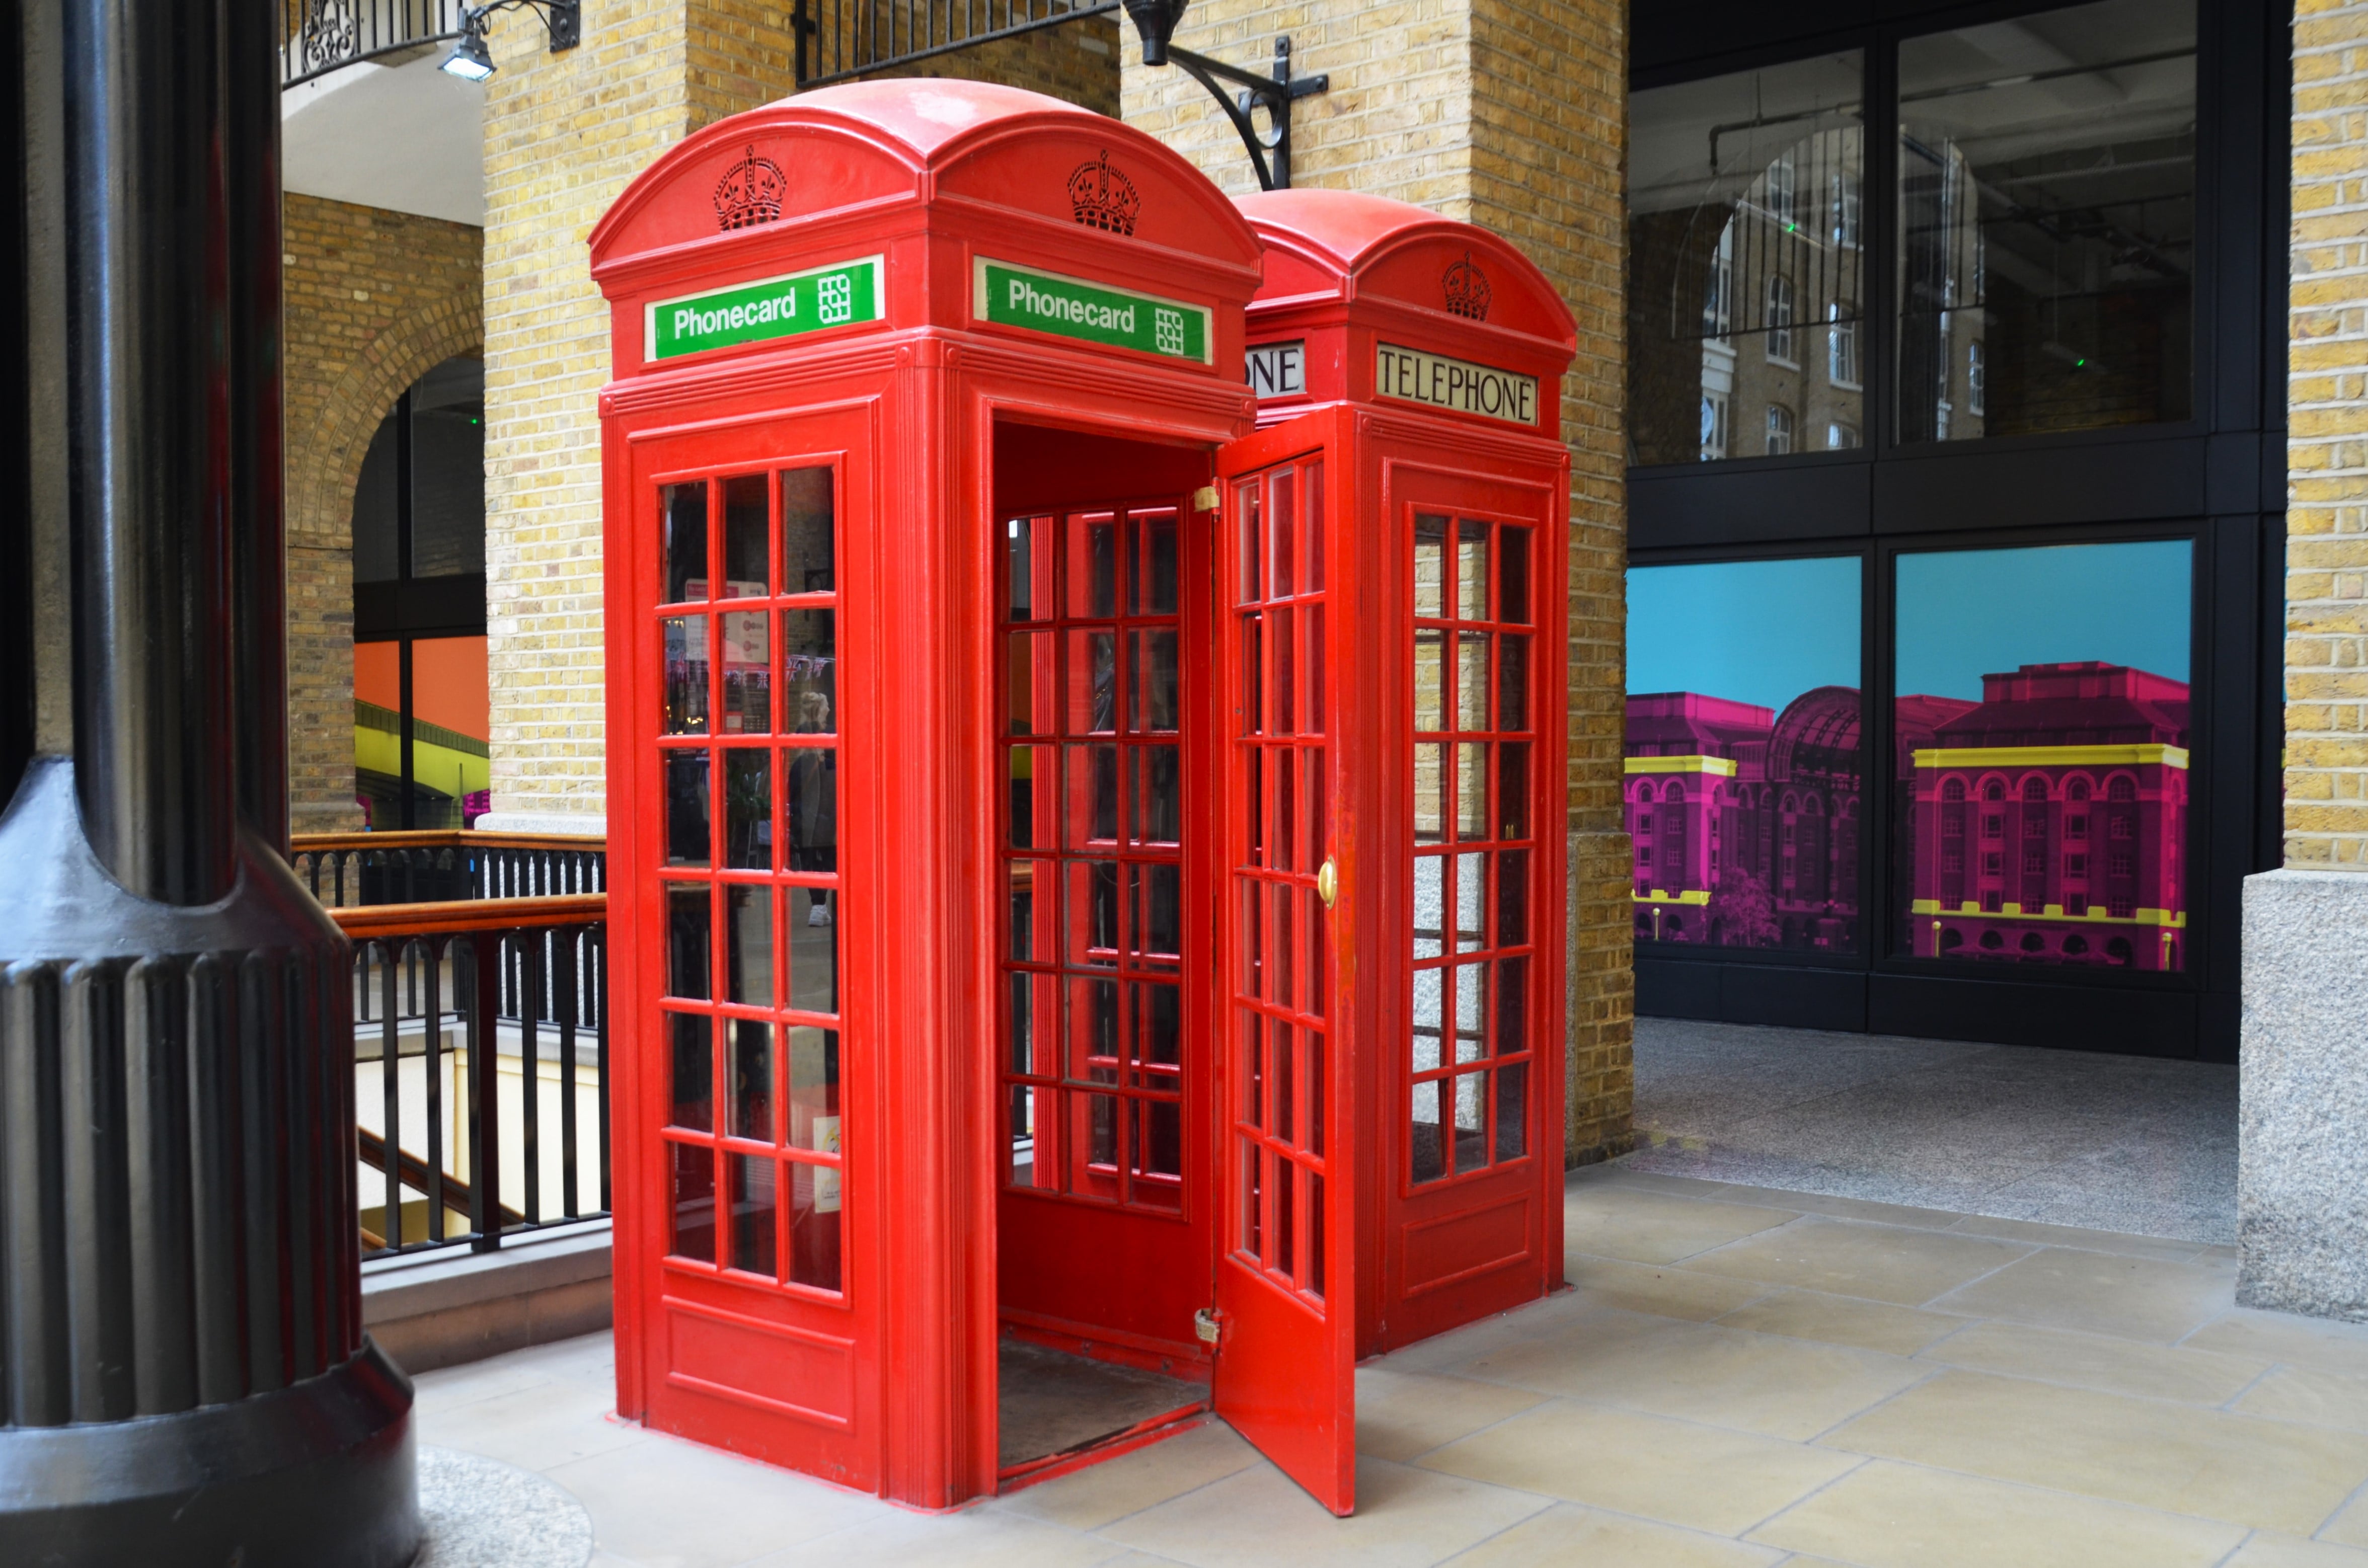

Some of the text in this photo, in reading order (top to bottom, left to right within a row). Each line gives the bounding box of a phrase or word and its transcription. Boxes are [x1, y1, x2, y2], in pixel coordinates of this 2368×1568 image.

[675, 287, 796, 339] Phonecard
[1009, 279, 1134, 333] Phonecard
[1245, 348, 1300, 393] NE
[1379, 351, 1531, 421] TELEPHONE
